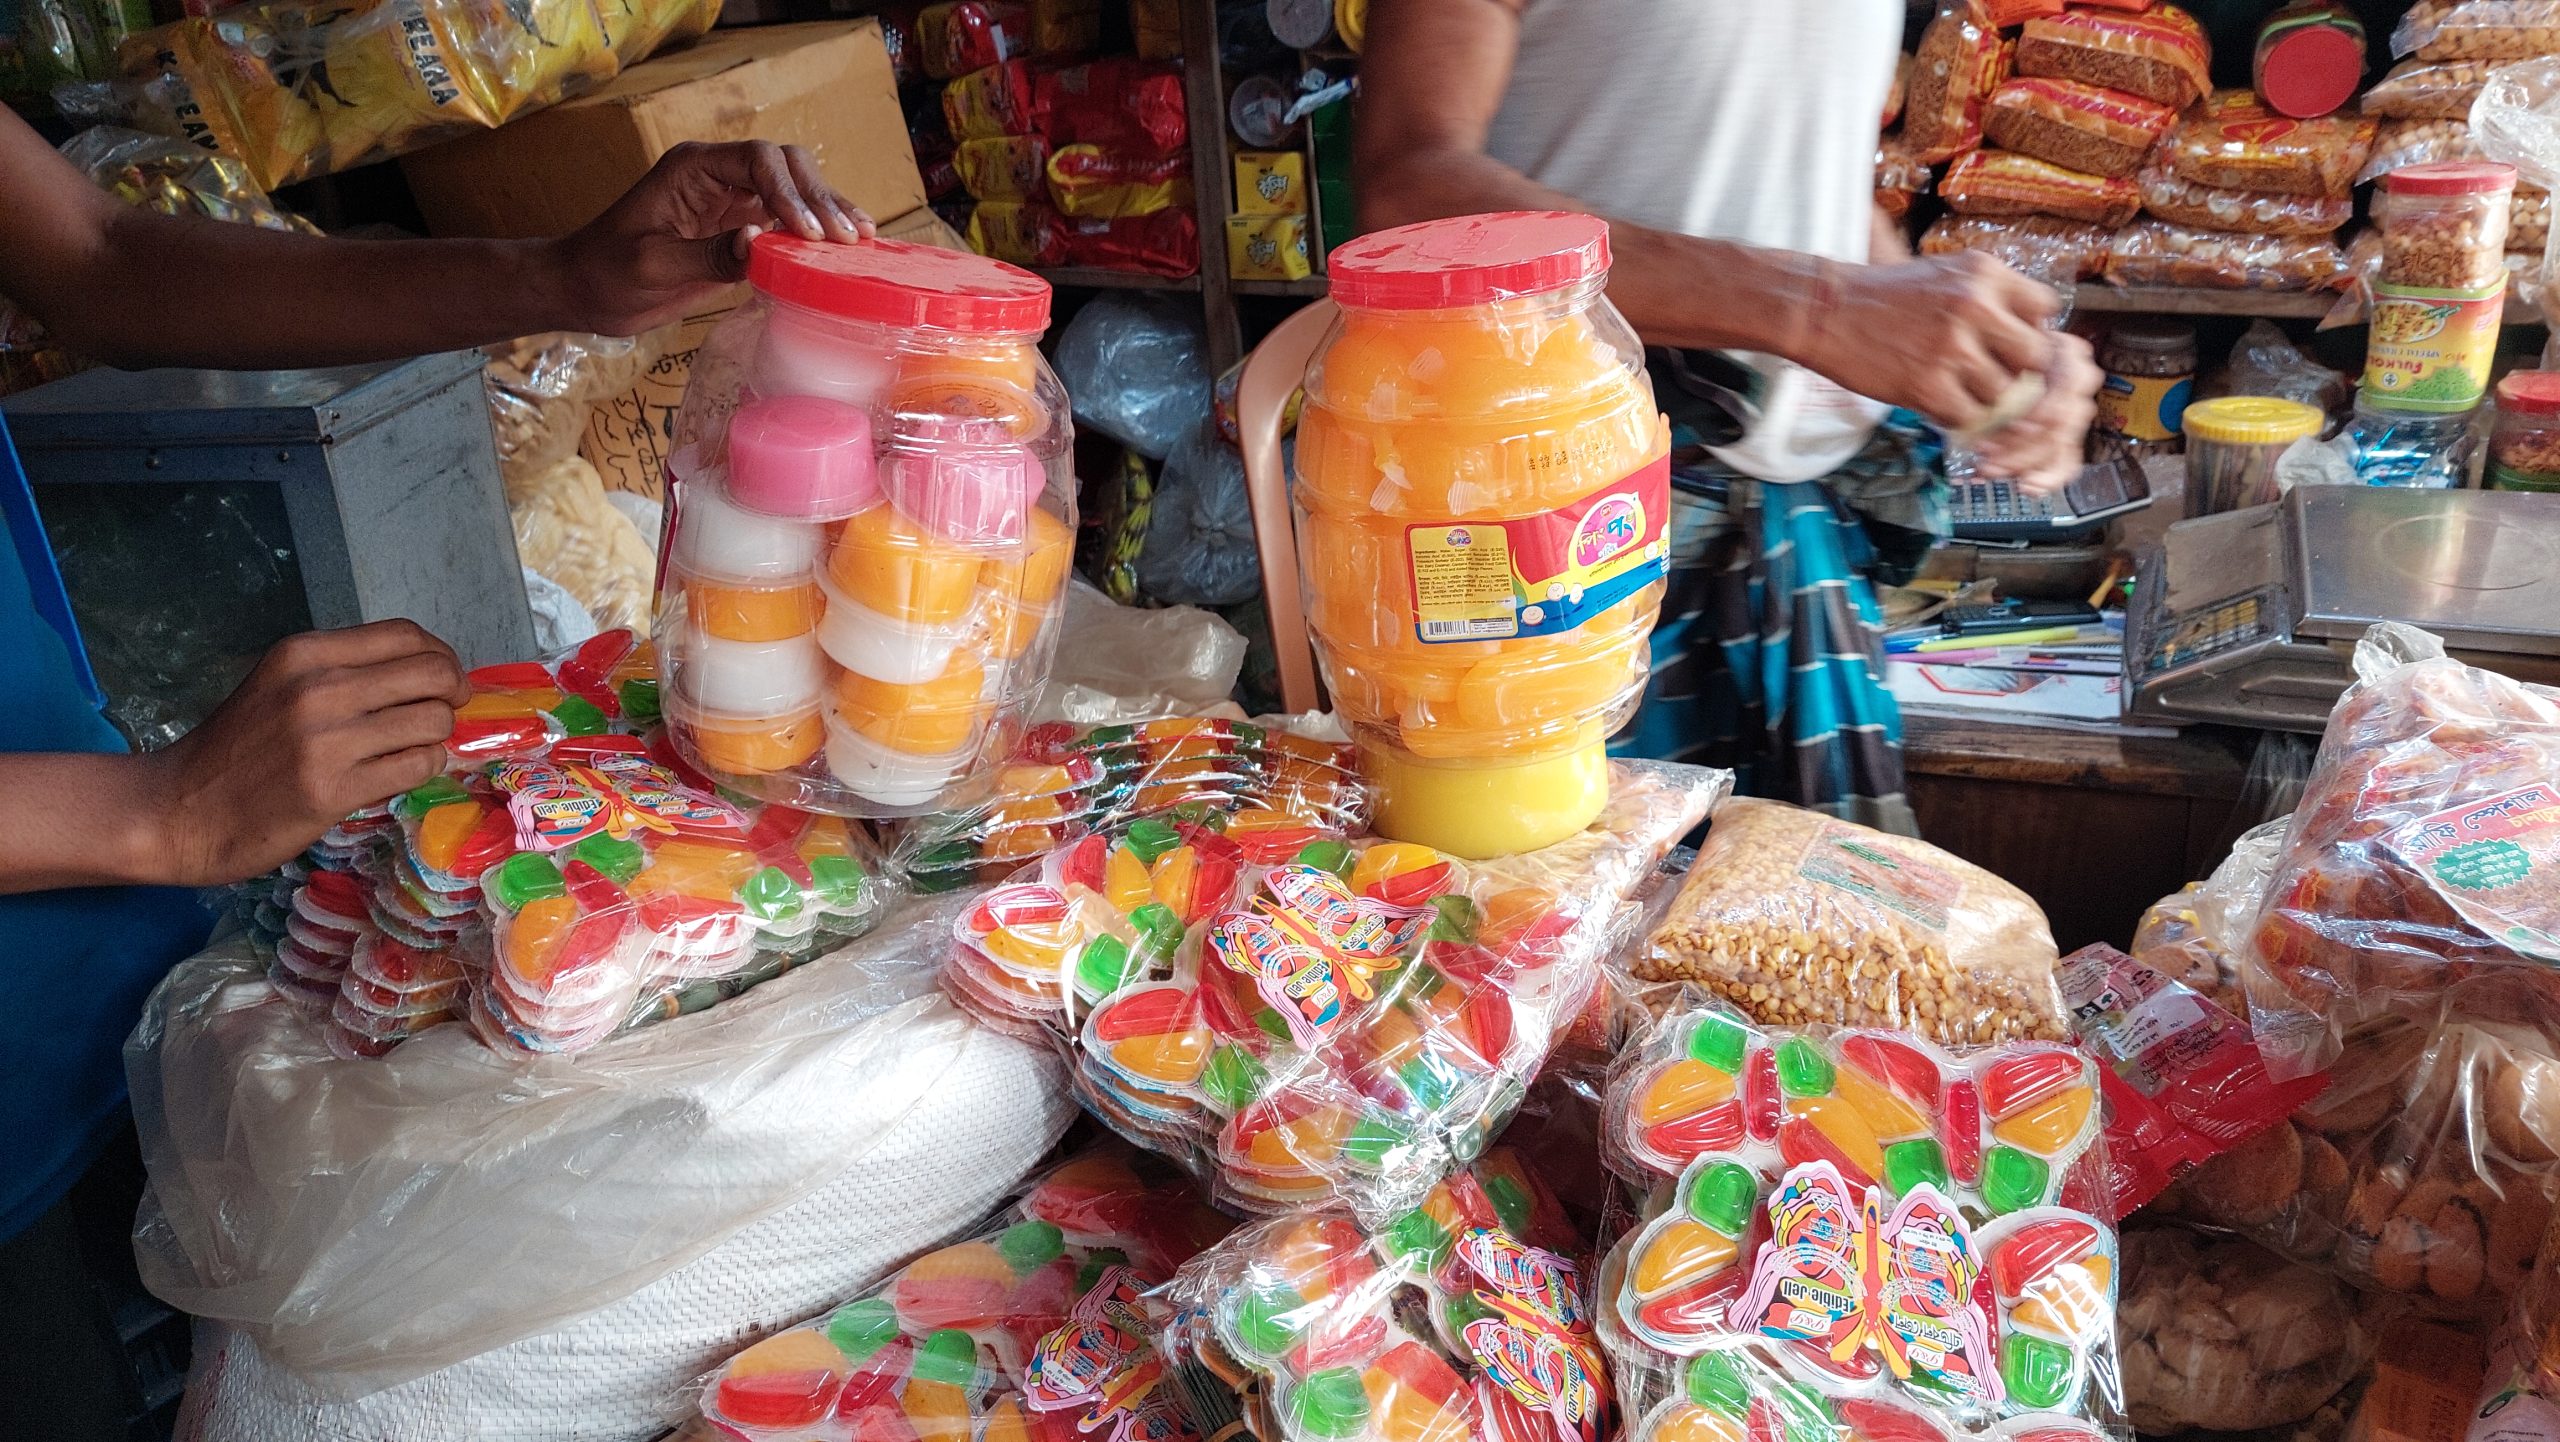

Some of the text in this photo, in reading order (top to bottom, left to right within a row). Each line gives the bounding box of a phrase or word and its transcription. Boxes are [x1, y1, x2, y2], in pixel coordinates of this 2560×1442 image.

[536, 799, 598, 817] Edible Jell
[1286, 959, 1328, 998] Edible Jell
[1783, 1280, 1849, 1312] Edible Jell
[1566, 1353, 1579, 1422] Edible Jell
